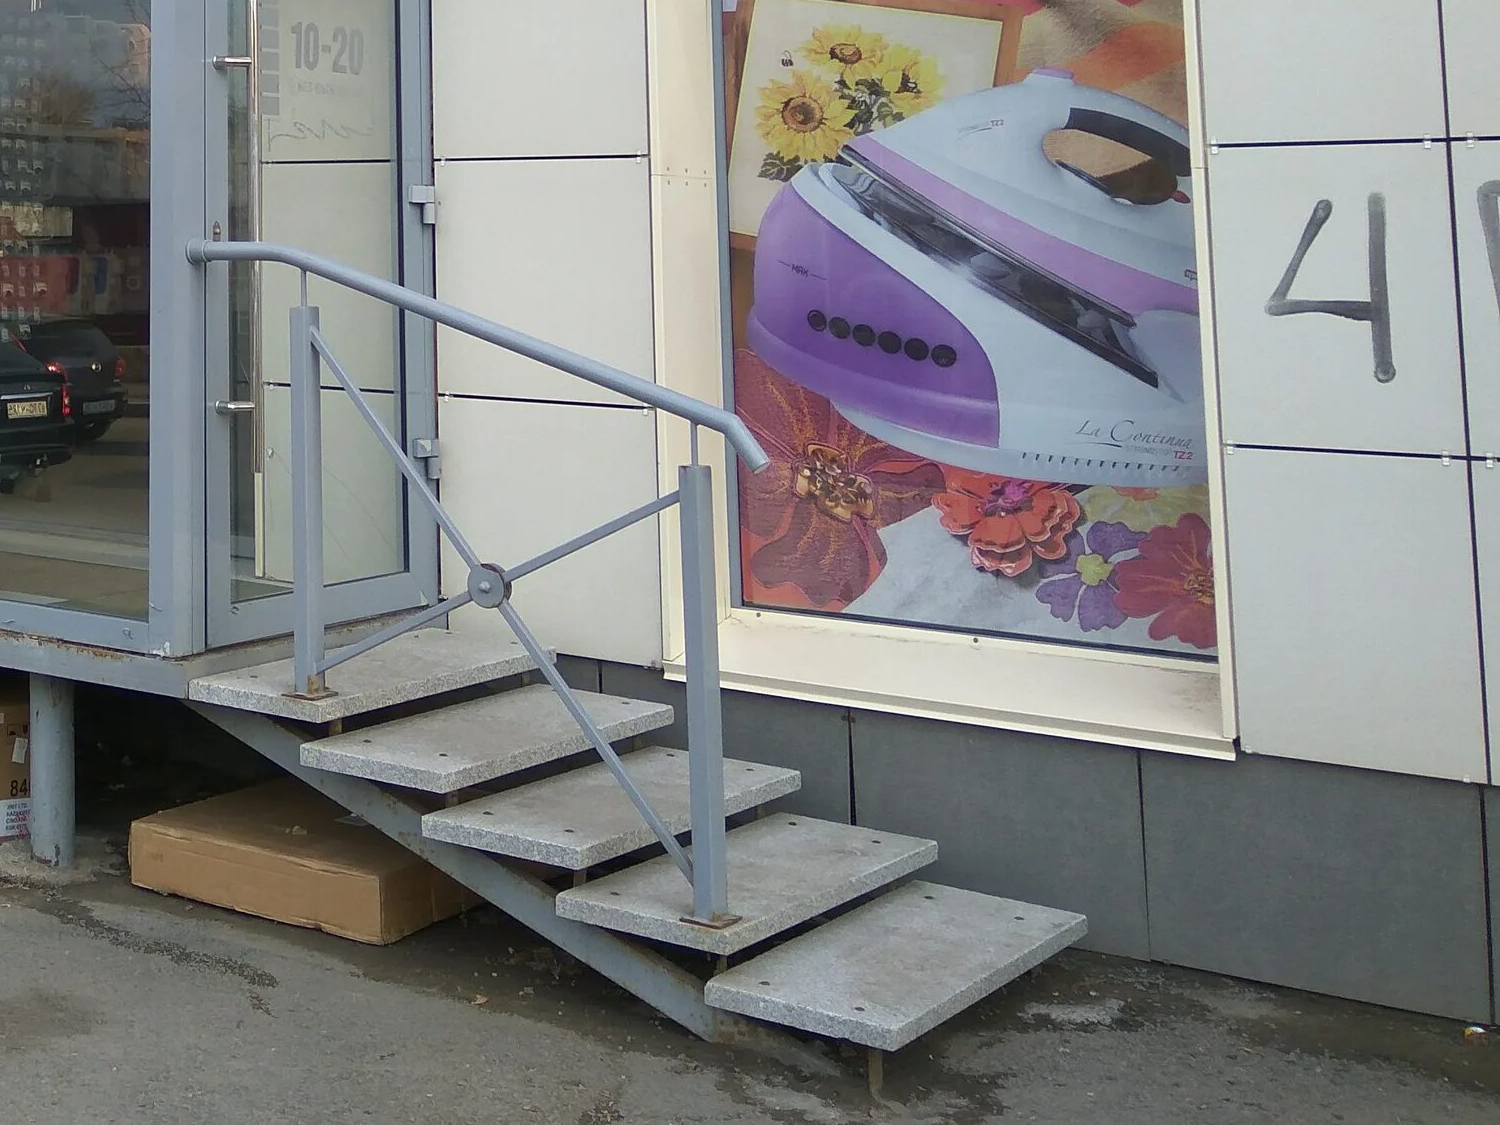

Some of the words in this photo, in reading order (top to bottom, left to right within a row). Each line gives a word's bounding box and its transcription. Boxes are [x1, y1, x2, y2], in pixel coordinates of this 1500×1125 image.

[290, 21, 364, 76] 10-20
[1076, 419, 1101, 437] La
[1110, 419, 1193, 449] Continua
[1173, 450, 1194, 461] TZ2
[9, 778, 31, 798] 84
